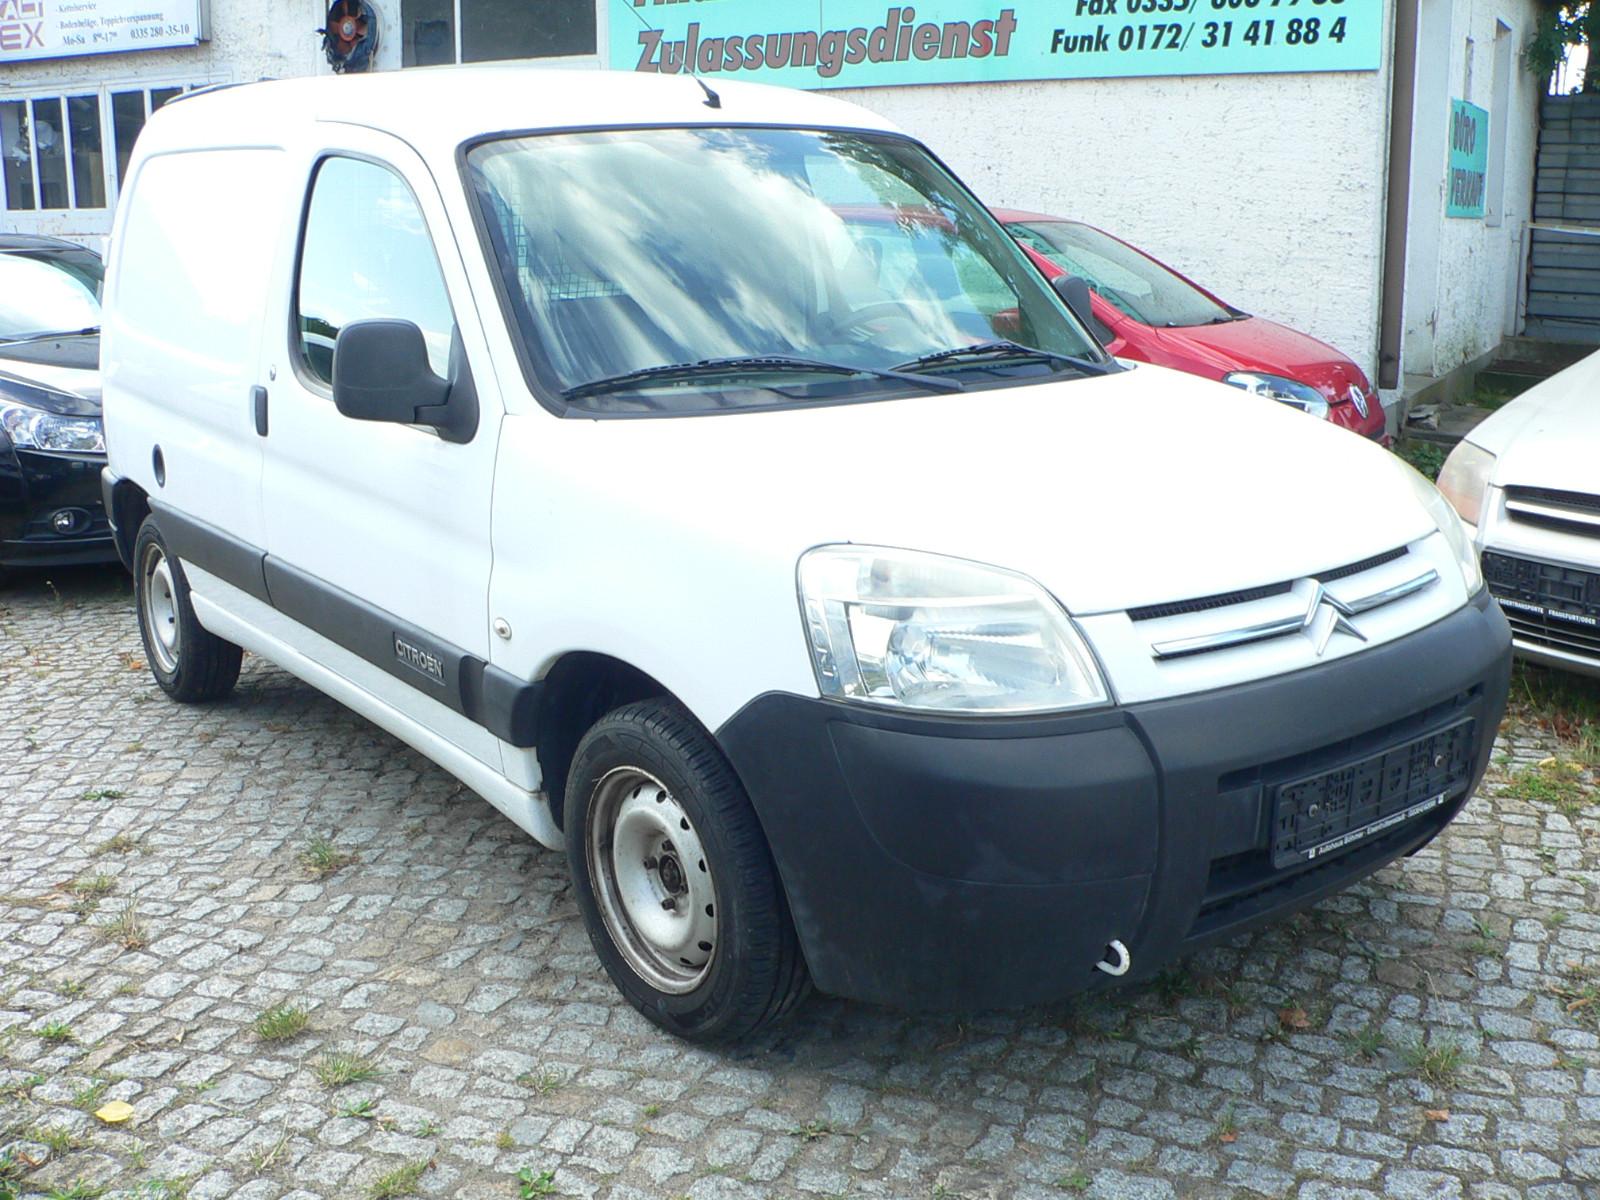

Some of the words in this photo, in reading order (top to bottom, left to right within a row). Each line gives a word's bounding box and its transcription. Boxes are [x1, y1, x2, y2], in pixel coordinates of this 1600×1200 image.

[636, 8, 1017, 77] Zulassungsdienst
[1050, 25, 1109, 53] Funk
[1118, 22, 1195, 51] 0172/
[1201, 21, 1232, 48] 31
[1243, 20, 1275, 46] 41
[1285, 17, 1320, 45] 88
[1328, 16, 1347, 43] 4
[395, 639, 444, 679] CITROËN
